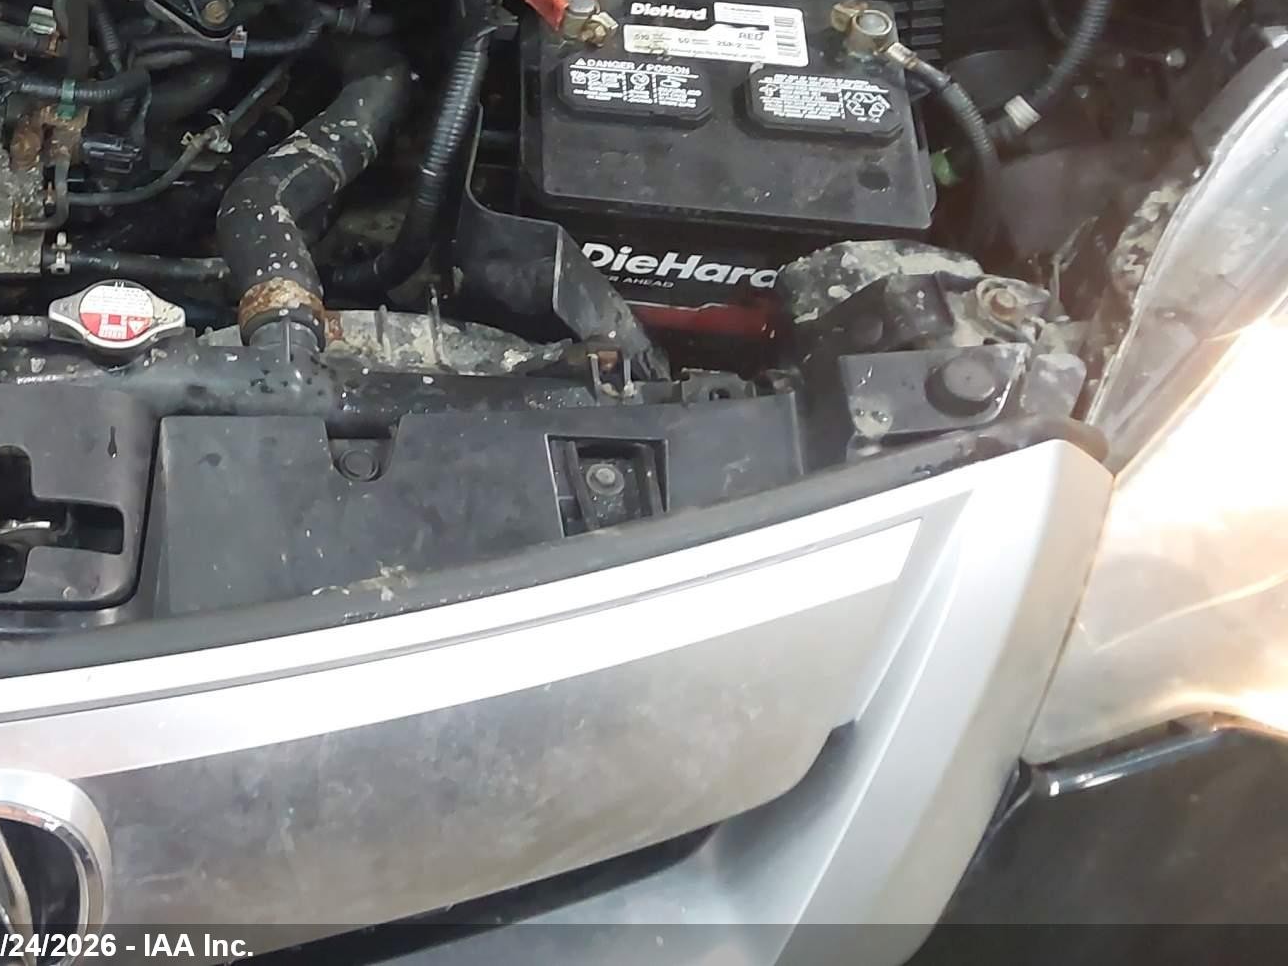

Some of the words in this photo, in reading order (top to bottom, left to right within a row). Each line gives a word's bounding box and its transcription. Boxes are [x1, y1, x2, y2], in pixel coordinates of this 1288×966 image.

[630, 2, 708, 21] DieHard
[586, 59, 635, 70] DANGER
[645, 63, 690, 75] POISON
[581, 242, 786, 289] DieHard
[623, 277, 674, 288] AHEAD
